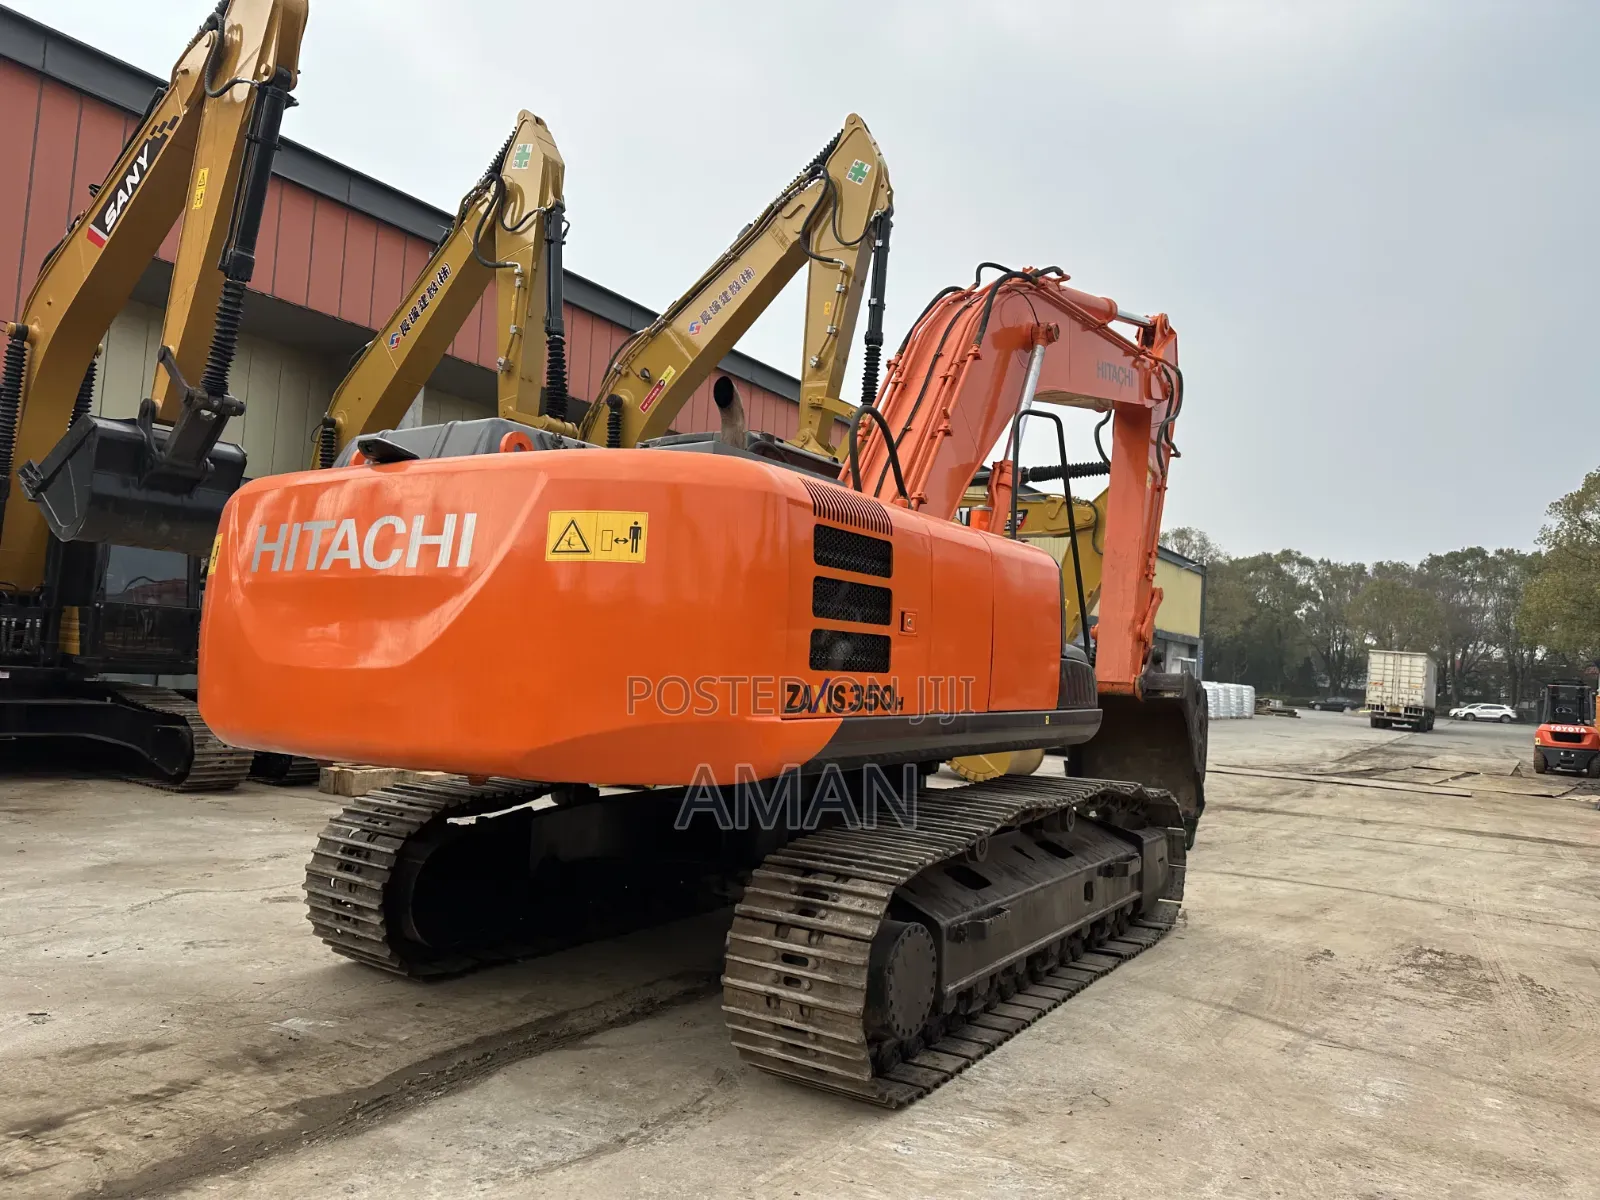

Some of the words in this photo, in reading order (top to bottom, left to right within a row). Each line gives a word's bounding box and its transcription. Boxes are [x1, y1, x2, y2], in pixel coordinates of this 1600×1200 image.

[104, 142, 149, 232] SANY
[1096, 360, 1134, 388] HITACHI
[251, 513, 478, 574] HITACHI
[1550, 725, 1587, 734] TOYOTA
